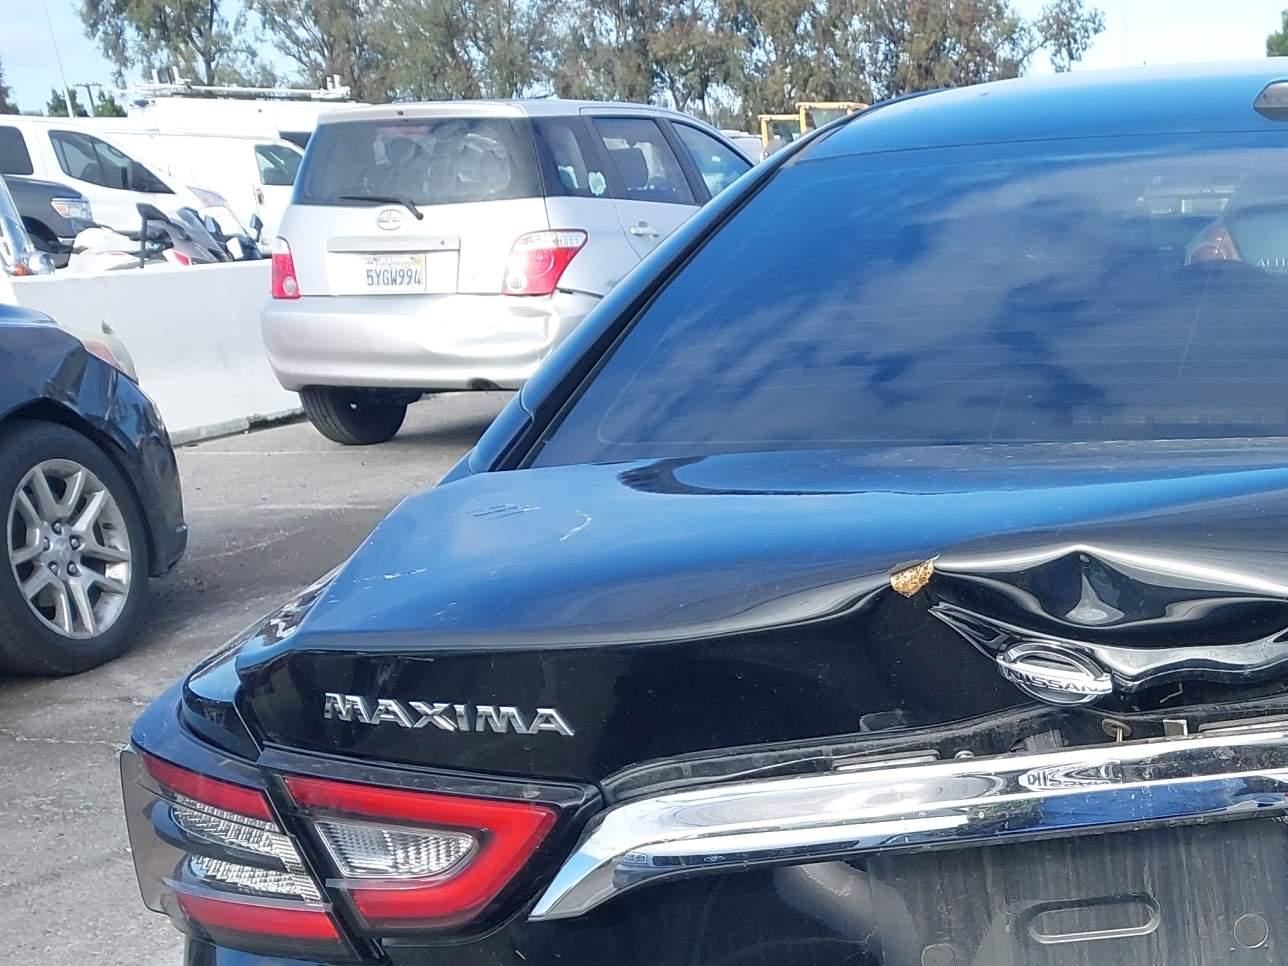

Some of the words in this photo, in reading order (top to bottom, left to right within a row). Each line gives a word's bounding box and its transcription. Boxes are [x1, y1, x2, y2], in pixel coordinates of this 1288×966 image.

[366, 268, 422, 287] 5YGW994
[1007, 666, 1101, 693] NISSAN
[323, 692, 576, 736] MAXIMA
